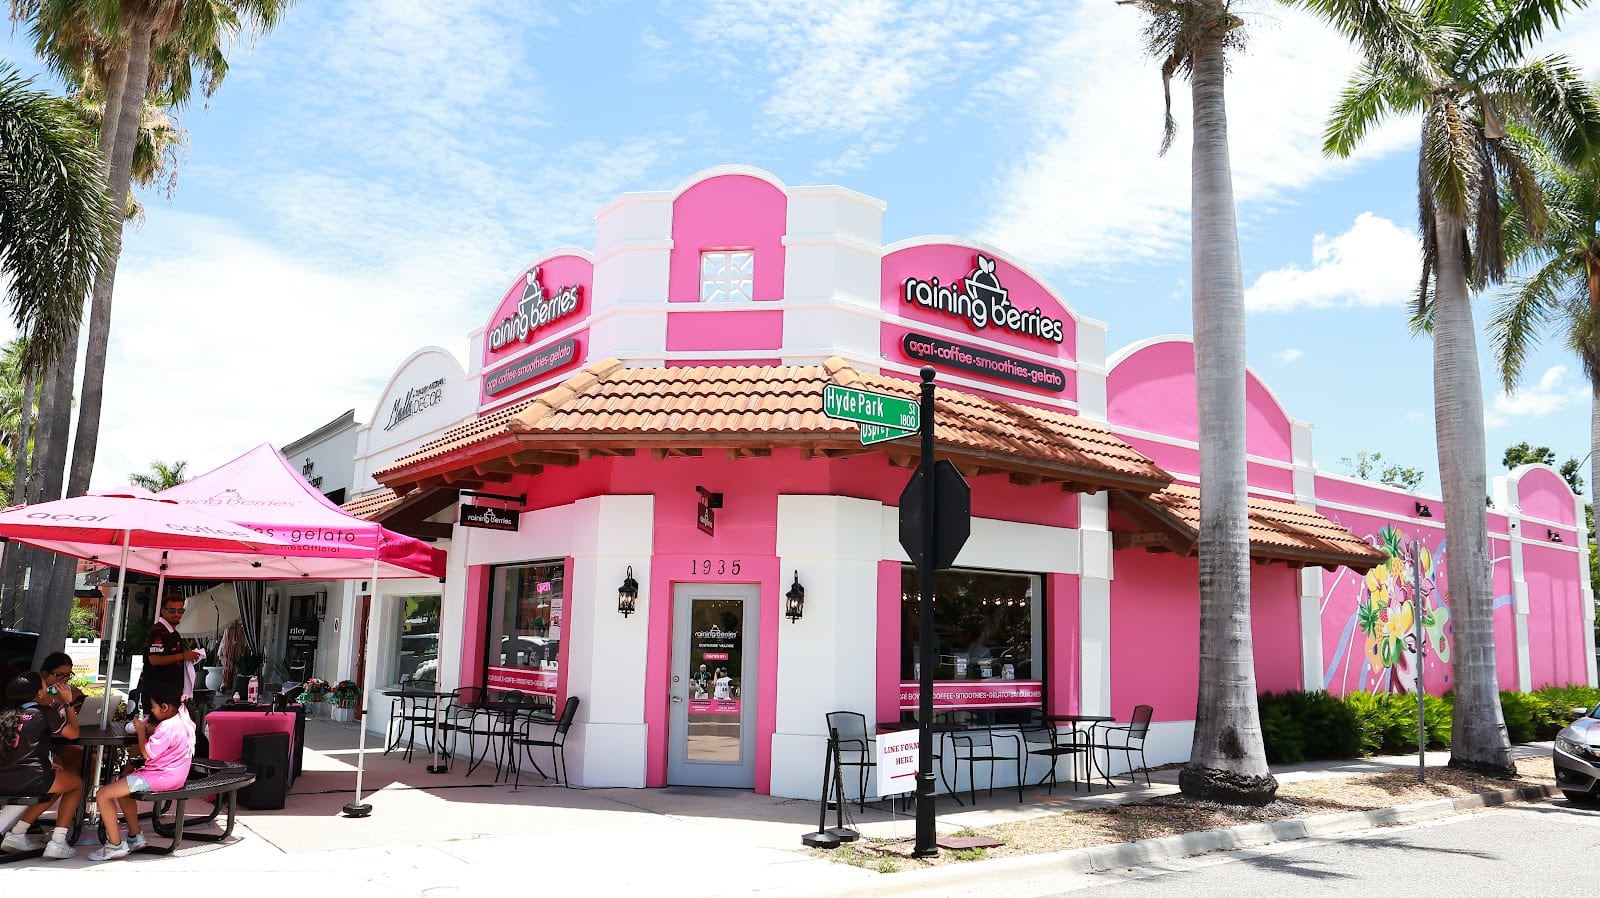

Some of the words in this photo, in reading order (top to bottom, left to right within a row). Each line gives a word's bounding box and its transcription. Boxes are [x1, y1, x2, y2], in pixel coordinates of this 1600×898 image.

[488, 313, 529, 350] raining
[530, 287, 578, 328] berries
[906, 278, 988, 328] raining
[991, 296, 1063, 343] berries
[937, 345, 973, 364] coffee
[975, 355, 1029, 378] smoothies
[1031, 368, 1062, 386] gelato
[827, 387, 857, 415] Hyde
[858, 393, 884, 418] Park
[908, 402, 916, 415] St
[900, 413, 916, 428] 1800
[165, 522, 251, 539] coffee
[290, 527, 356, 543] gelato
[691, 559, 741, 576] 1935
[883, 744, 900, 755] LINE
[900, 741, 920, 752] FORM
[895, 755, 914, 766] HERE
